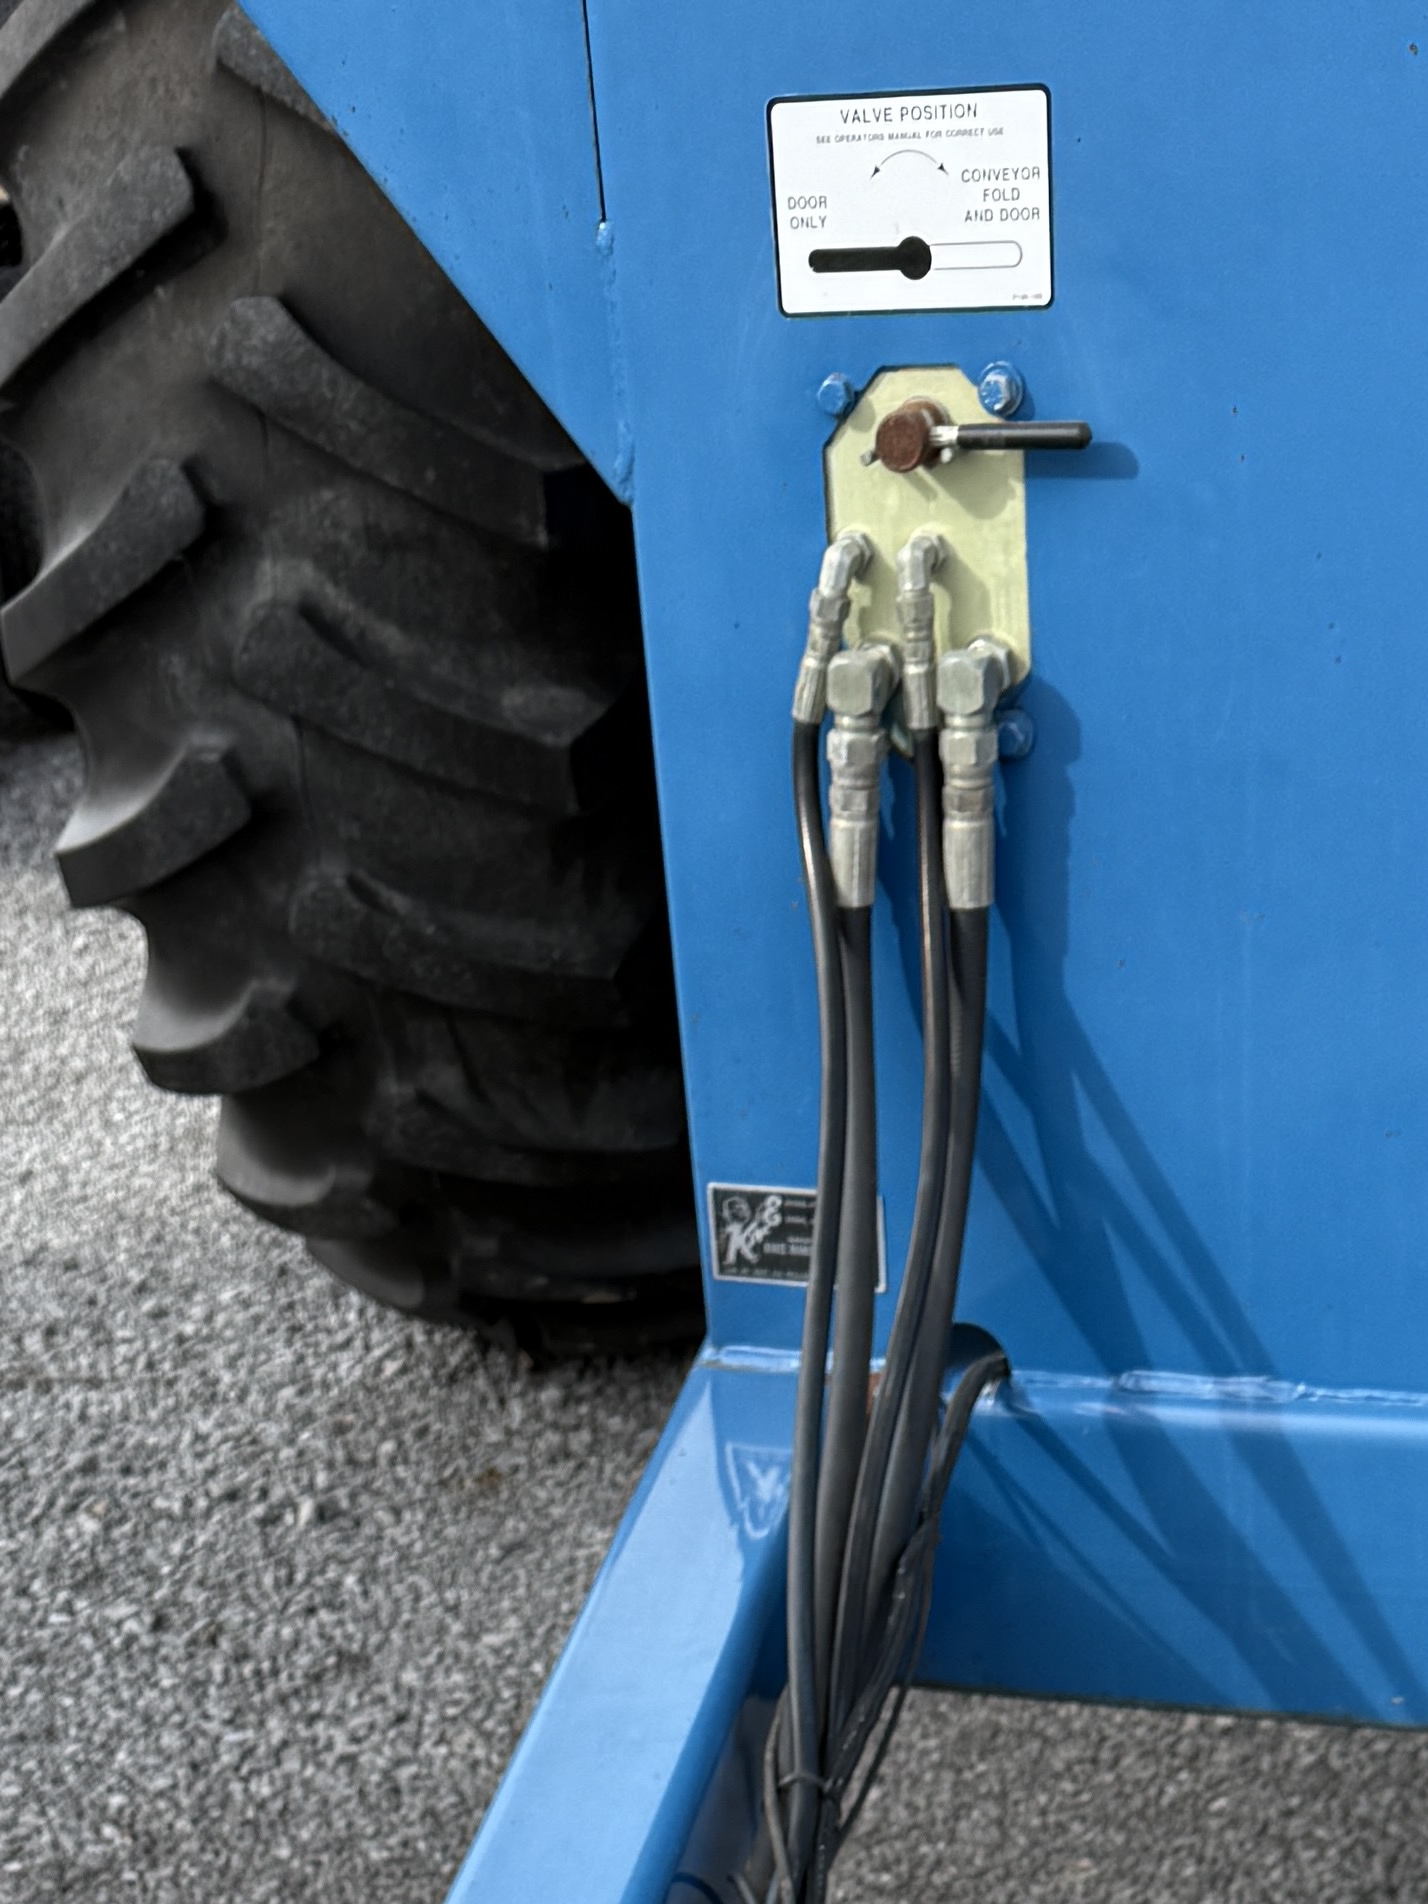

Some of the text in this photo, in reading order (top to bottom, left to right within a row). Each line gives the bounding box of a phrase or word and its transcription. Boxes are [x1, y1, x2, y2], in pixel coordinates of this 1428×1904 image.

[840, 103, 978, 124] VALVE POSITION
[960, 166, 1041, 183] CONVEYOR
[787, 195, 828, 210] DOOR
[983, 187, 1021, 203] FOLD
[964, 207, 1041, 222] AND DOOR
[789, 215, 828, 230] ONLY
